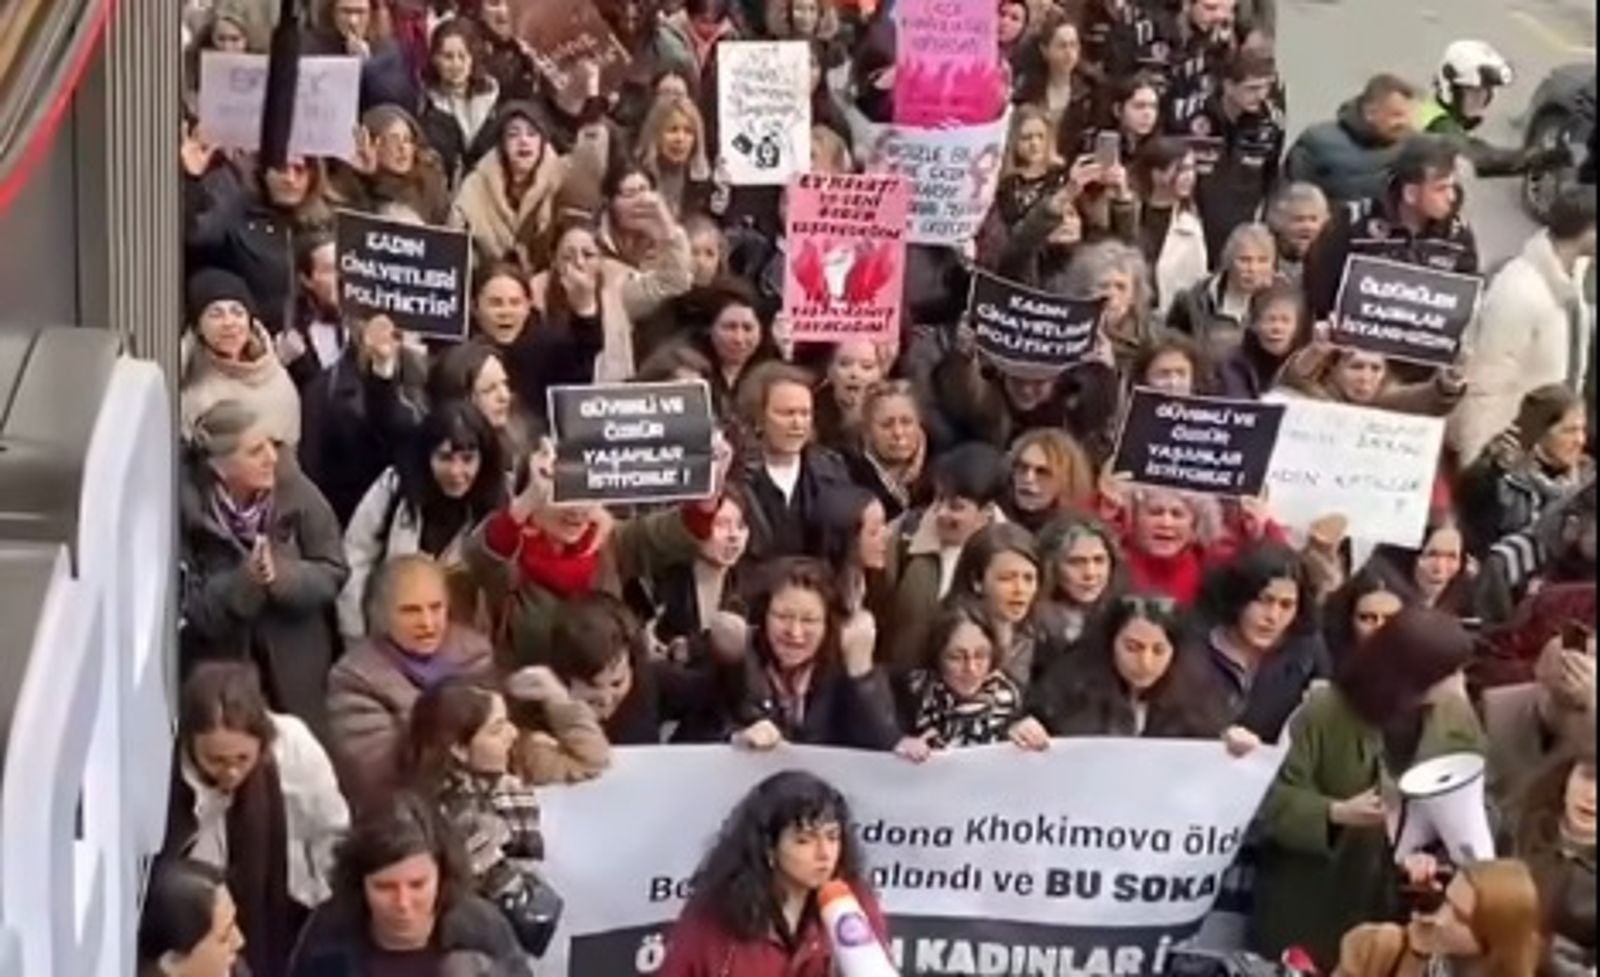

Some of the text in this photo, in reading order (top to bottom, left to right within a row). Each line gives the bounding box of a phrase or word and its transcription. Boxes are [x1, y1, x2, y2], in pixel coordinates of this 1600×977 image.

[965, 813, 1173, 852] Khokimova
[1184, 826, 1240, 855] öld
[872, 861, 982, 892] alandı
[992, 869, 1035, 897] ve
[1045, 867, 1103, 900] BU
[1112, 872, 1216, 904] SOKA
[915, 937, 1145, 977] KADINLAR
